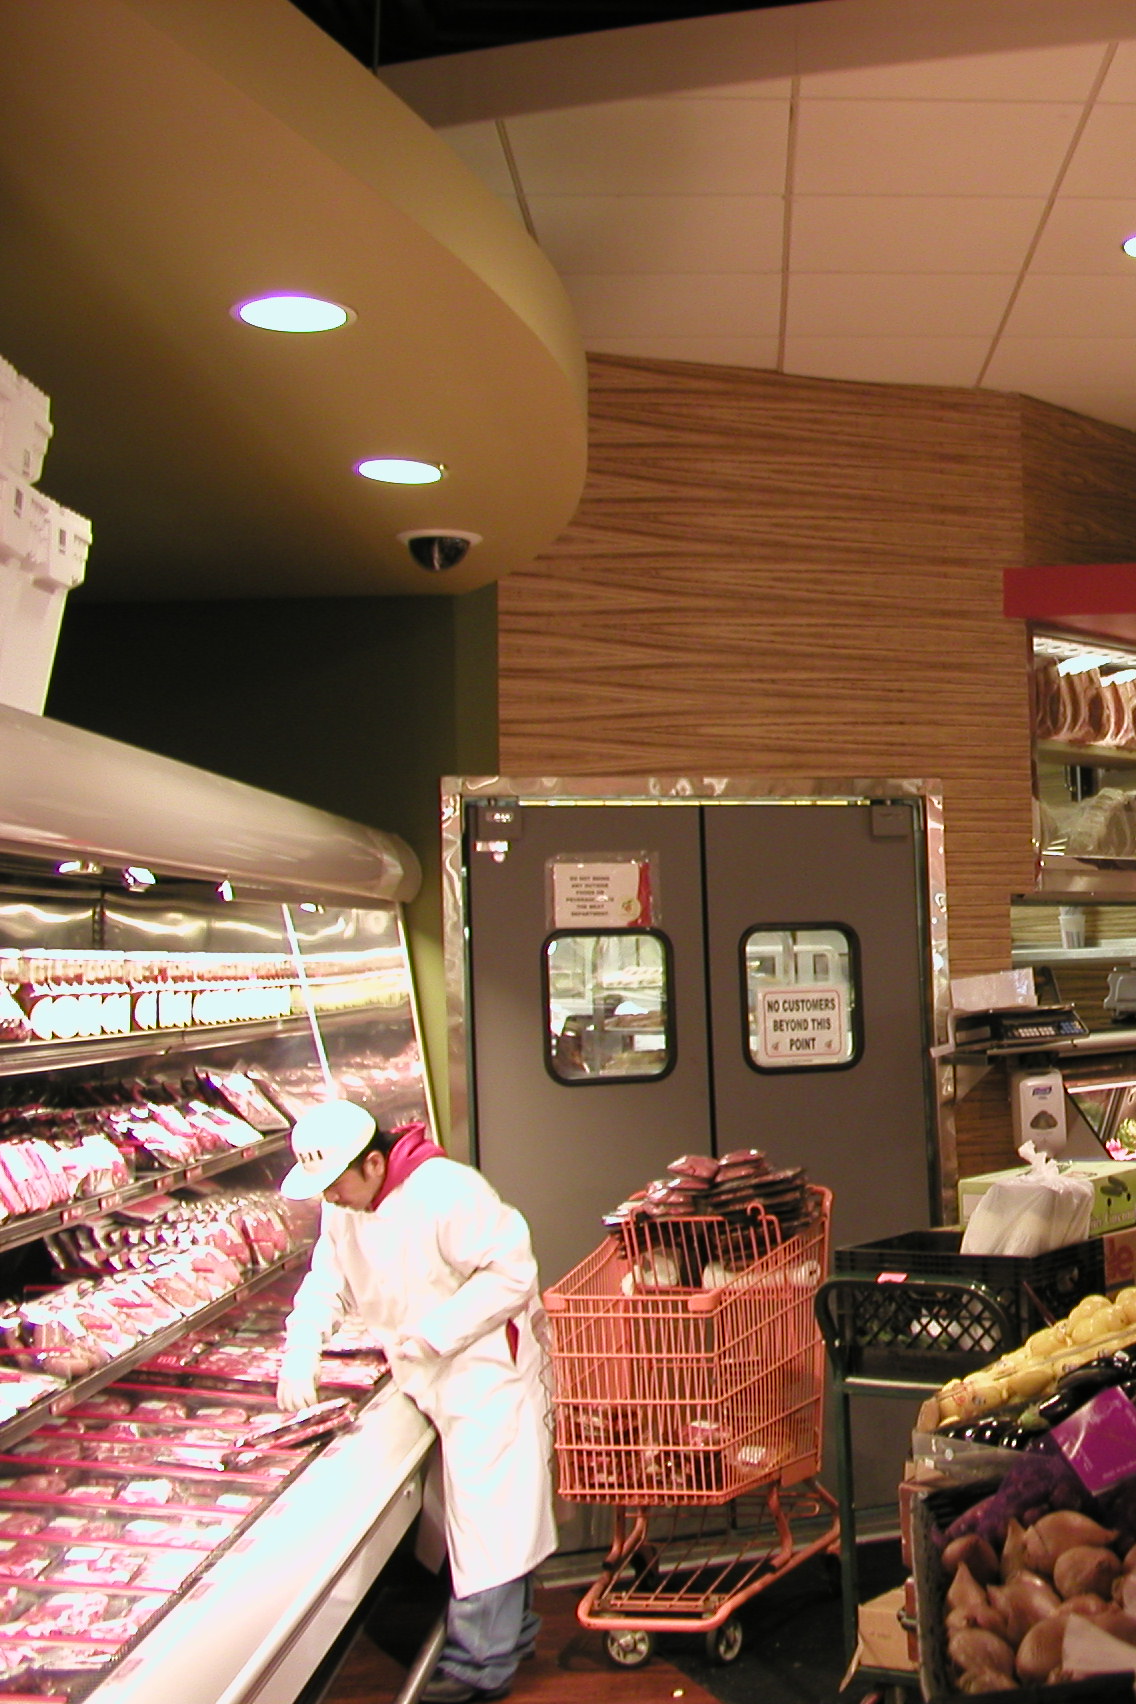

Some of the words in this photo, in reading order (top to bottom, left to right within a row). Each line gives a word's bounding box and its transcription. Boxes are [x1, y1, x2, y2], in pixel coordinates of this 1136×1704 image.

[767, 1000, 780, 1013] NO
[782, 998, 837, 1013] CUSTOMERS
[773, 1018, 809, 1032] BEYOND
[811, 1017, 832, 1031] THIS
[789, 1037, 817, 1051] POINT
